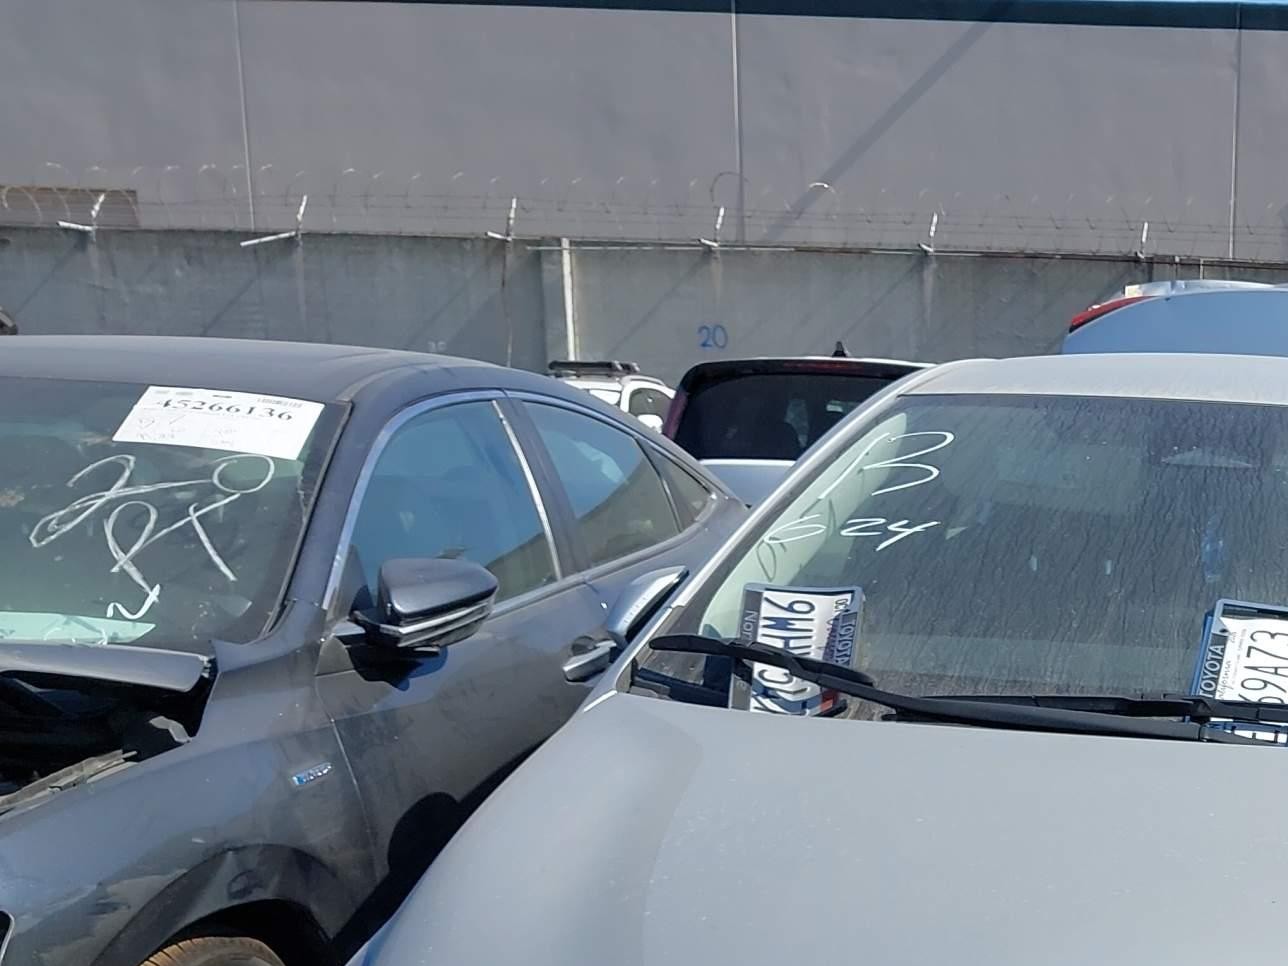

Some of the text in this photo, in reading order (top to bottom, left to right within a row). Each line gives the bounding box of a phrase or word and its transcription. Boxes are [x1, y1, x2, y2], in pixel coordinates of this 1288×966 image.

[697, 325, 729, 350] 20
[157, 398, 293, 421] 45266136
[834, 619, 857, 665] TOYOTA
[1200, 644, 1225, 699] TOYOTA
